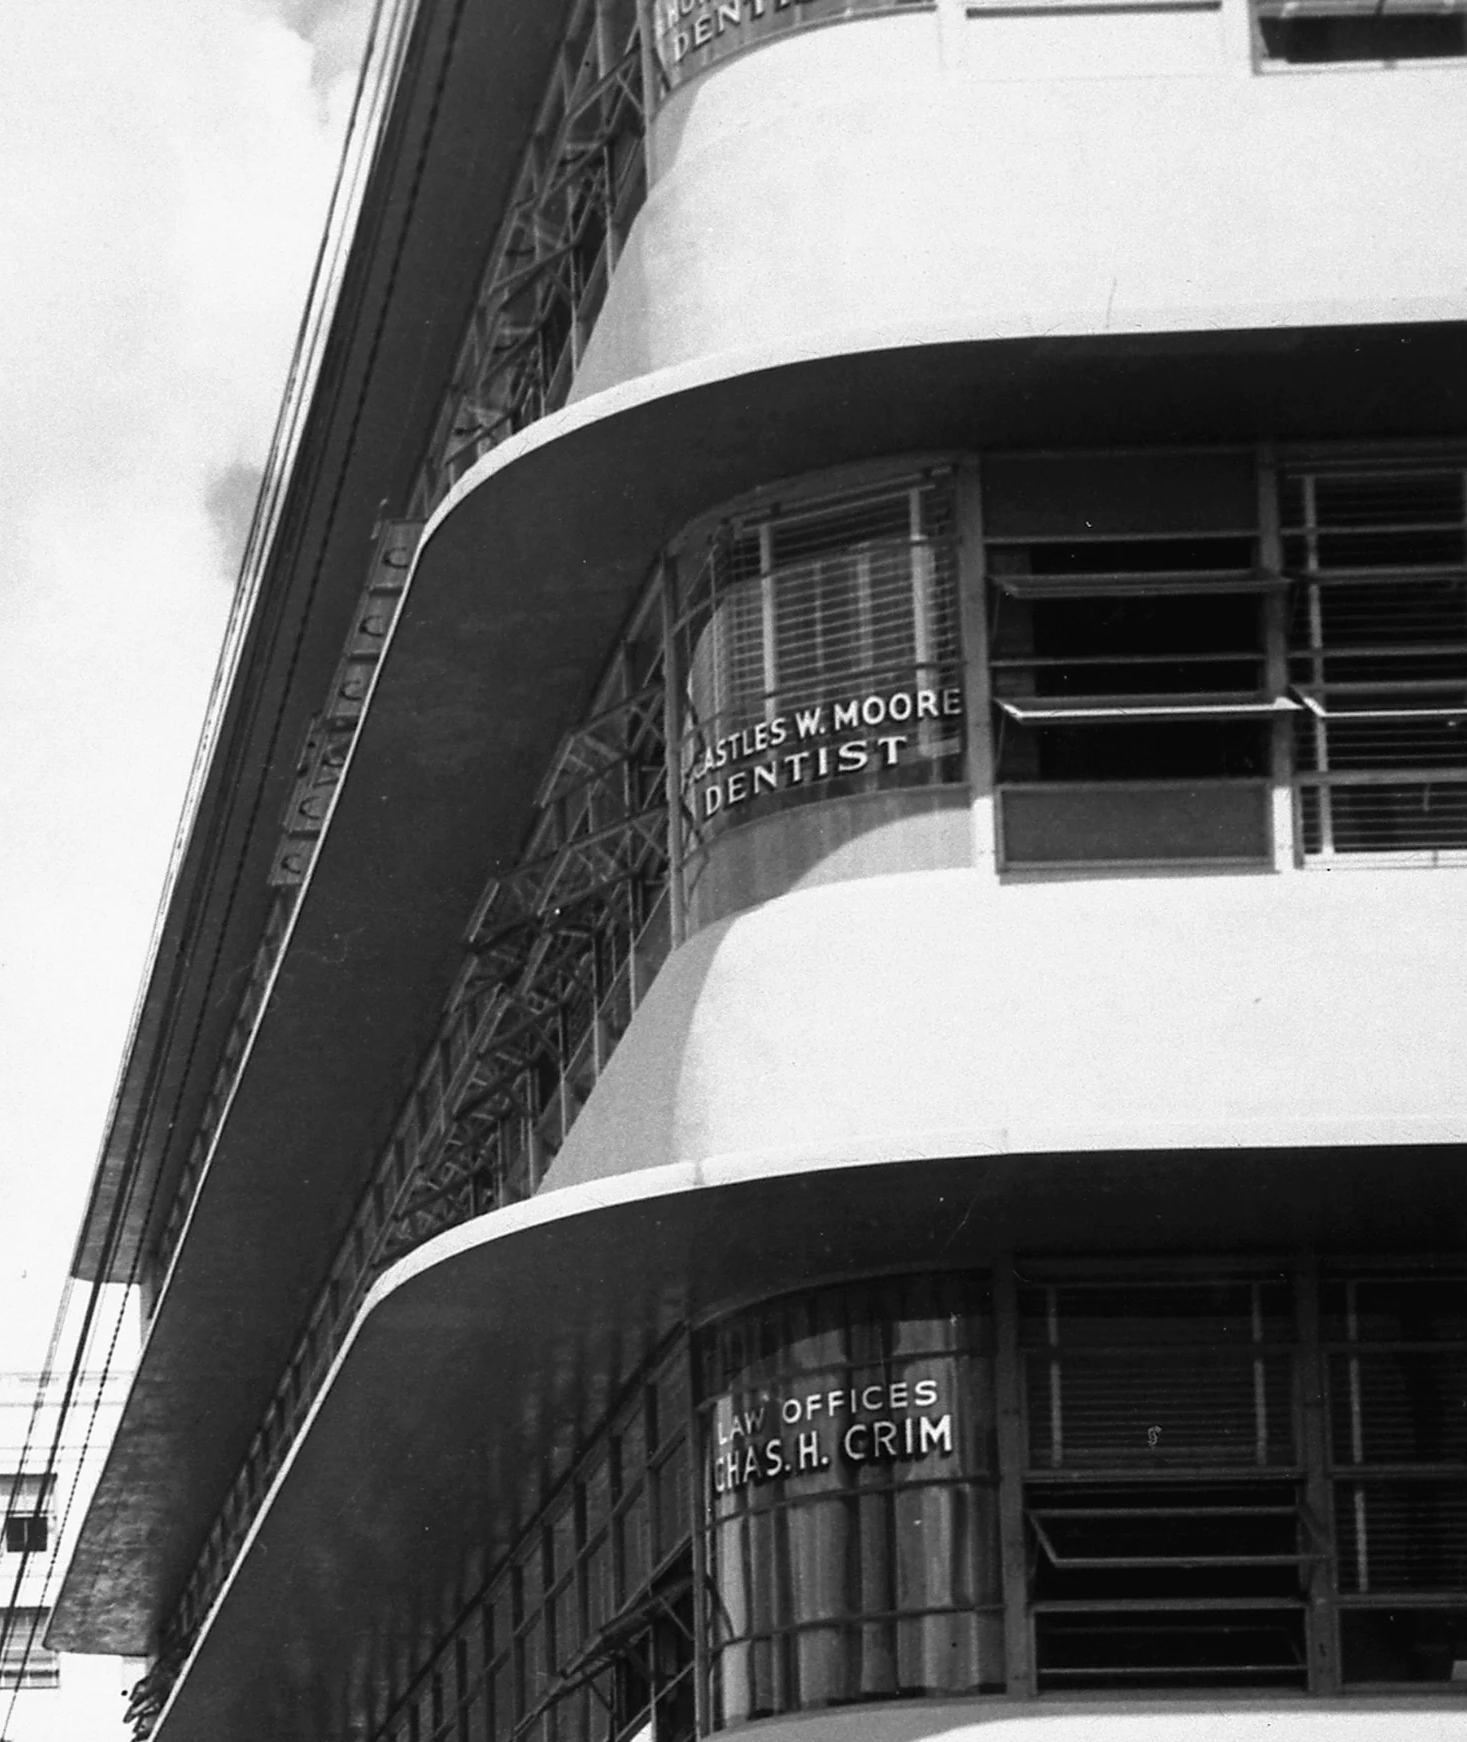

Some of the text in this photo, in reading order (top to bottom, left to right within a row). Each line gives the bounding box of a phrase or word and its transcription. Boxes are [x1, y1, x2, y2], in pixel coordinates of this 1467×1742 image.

[796, 708, 826, 738] W.
[834, 688, 962, 730] MOORE
[705, 735, 907, 816] DENTIST
[718, 1380, 938, 1445] LAW OFFICES
[715, 1414, 953, 1492] CHAS. H. CRIM
